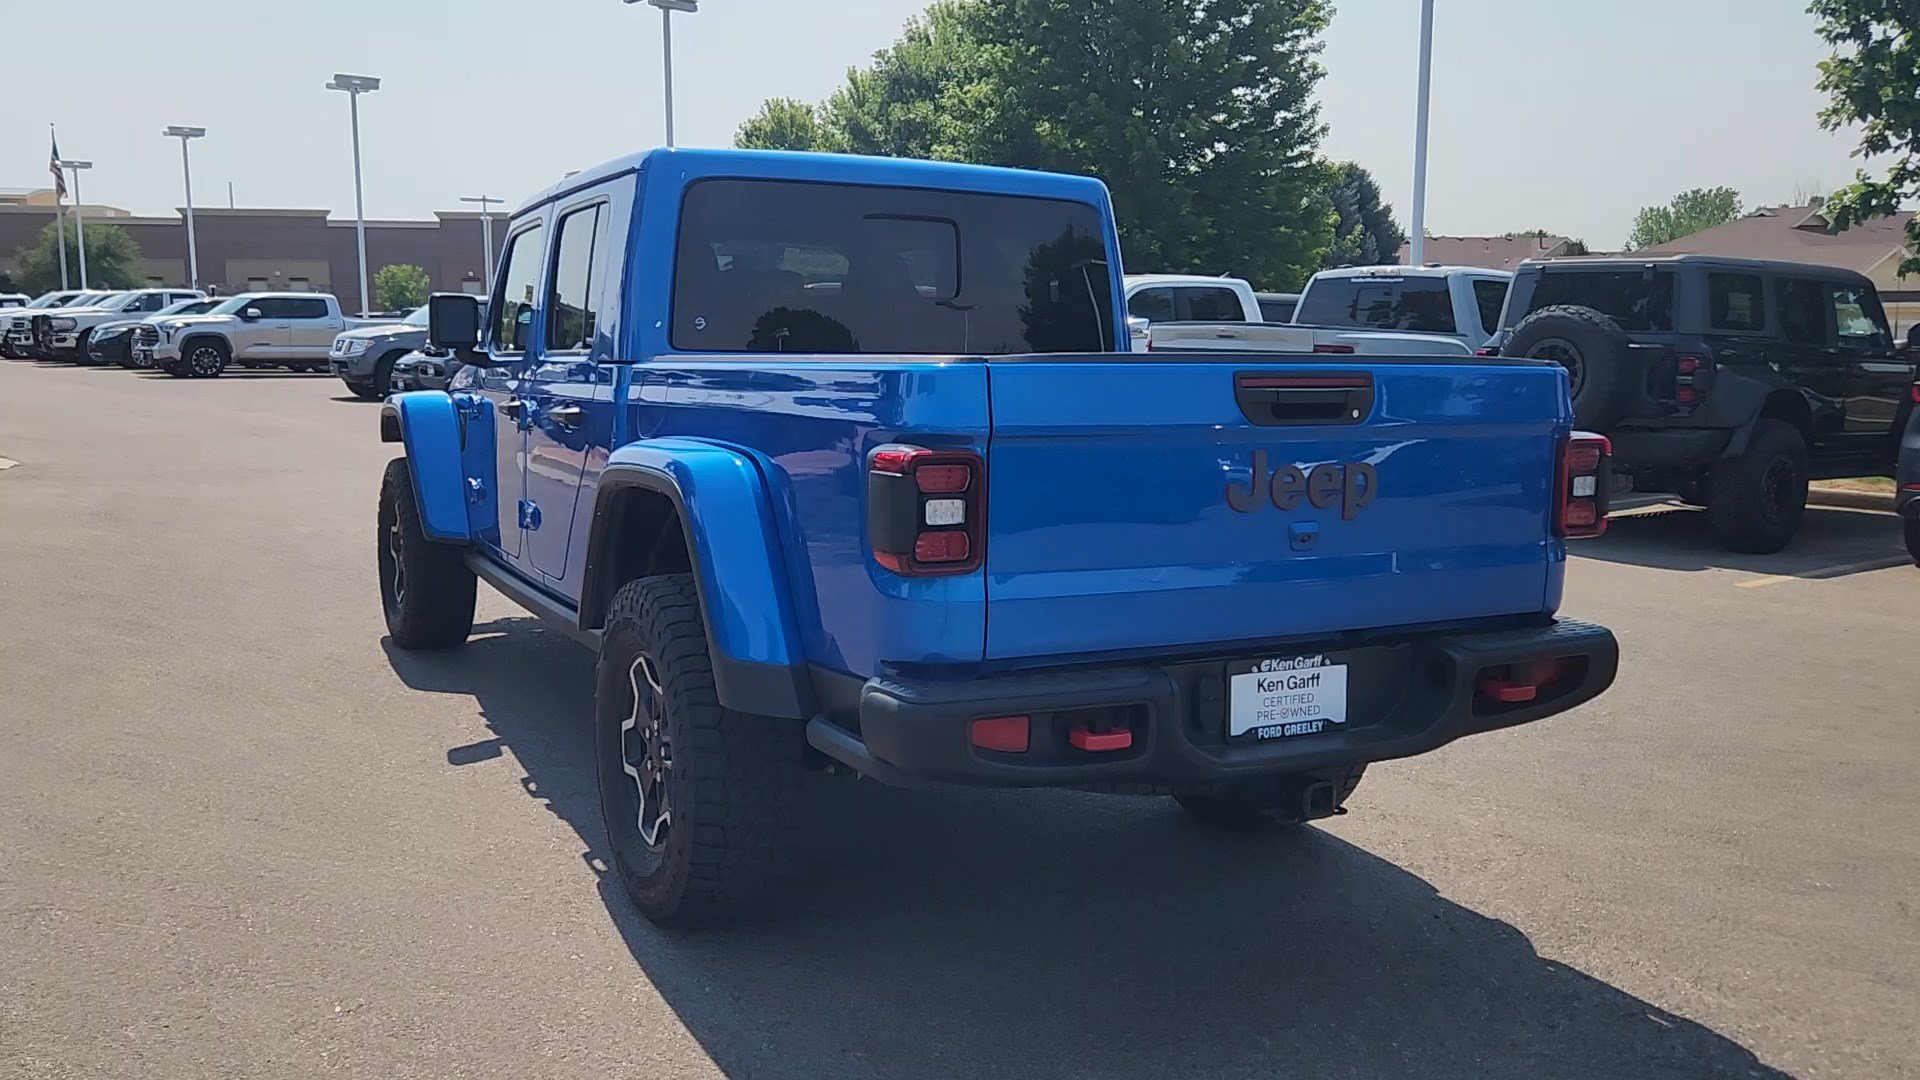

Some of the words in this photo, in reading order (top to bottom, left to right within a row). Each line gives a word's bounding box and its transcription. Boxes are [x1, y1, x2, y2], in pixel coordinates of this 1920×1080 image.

[1225, 449, 1379, 521] Jeep
[1271, 659, 1294, 672] Ken
[1294, 655, 1323, 669] Garff
[1257, 678, 1284, 693] Ken
[1287, 673, 1321, 690] Garff
[1263, 693, 1315, 707] CERTIFIED
[1258, 726, 1282, 739] FORD
[1284, 720, 1324, 736] GREELEY
